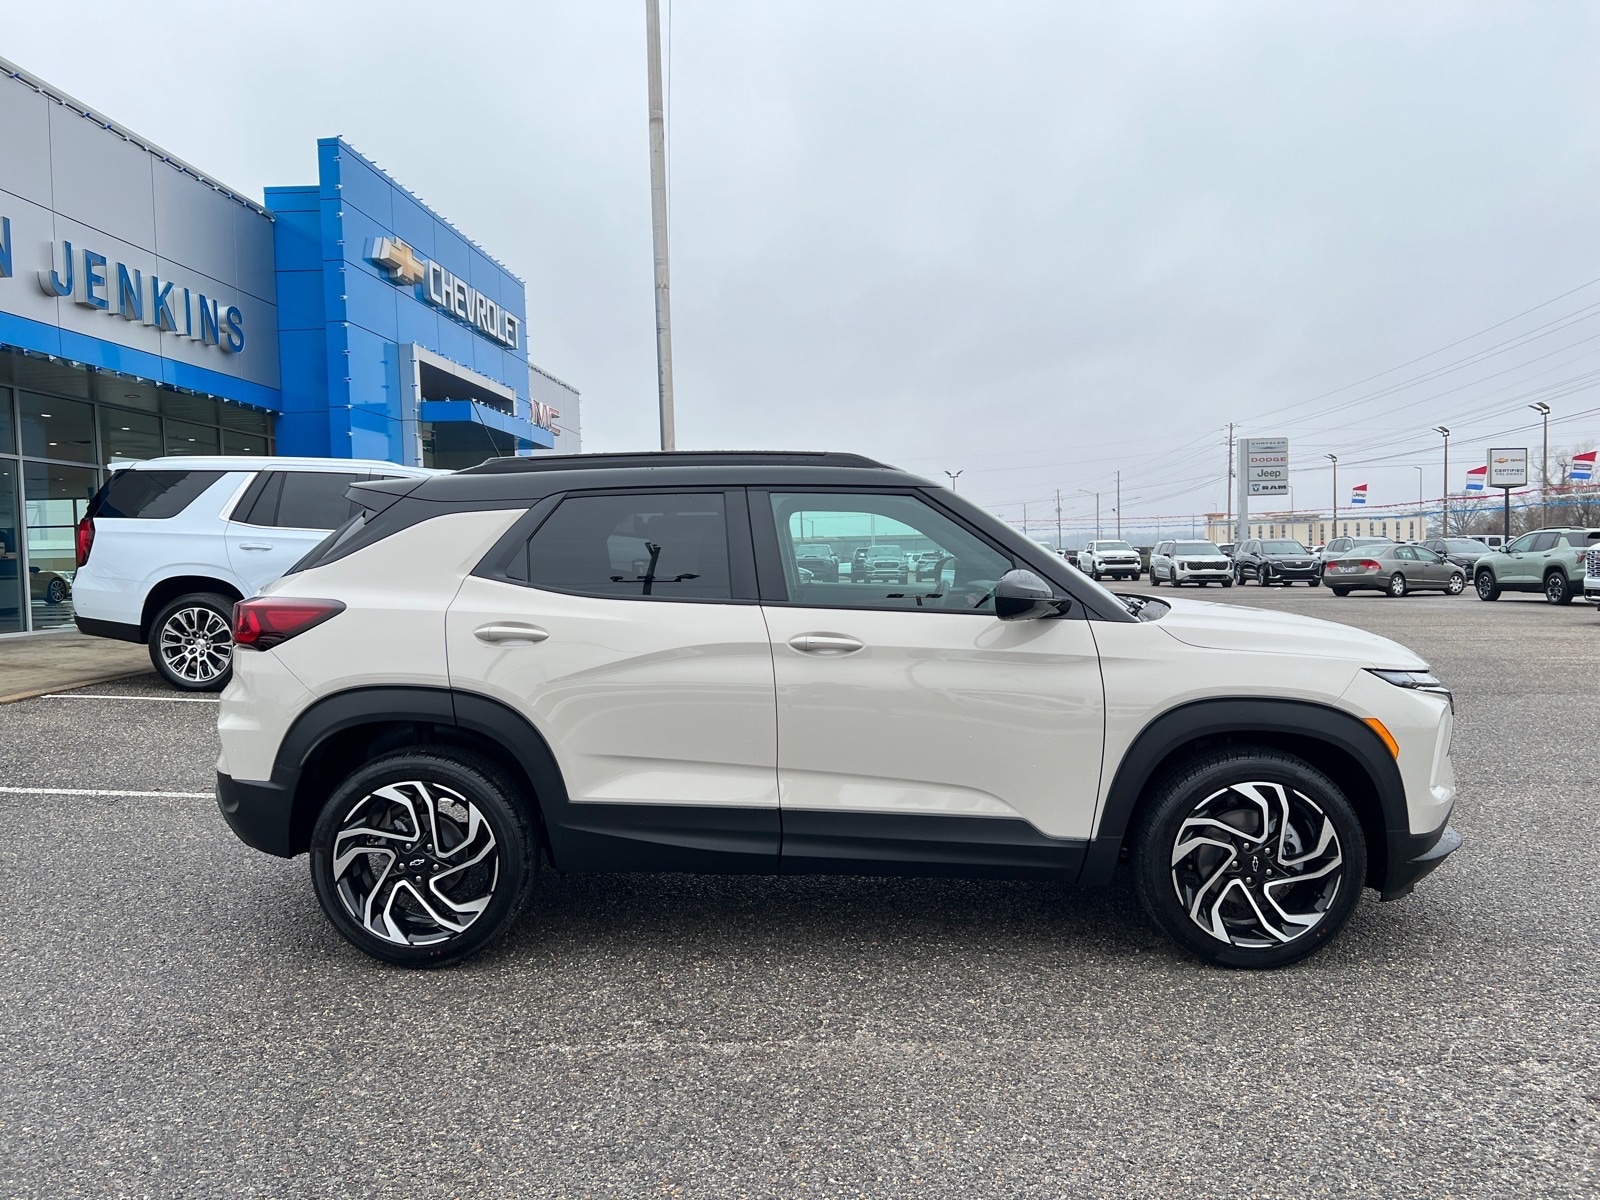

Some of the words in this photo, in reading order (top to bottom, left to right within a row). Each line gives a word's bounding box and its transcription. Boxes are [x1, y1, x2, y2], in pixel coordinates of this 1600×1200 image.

[40, 240, 245, 353] JENKINS
[423, 259, 520, 350] CHEVROLET
[530, 398, 560, 436] MC
[1257, 469, 1281, 478] Jeep
